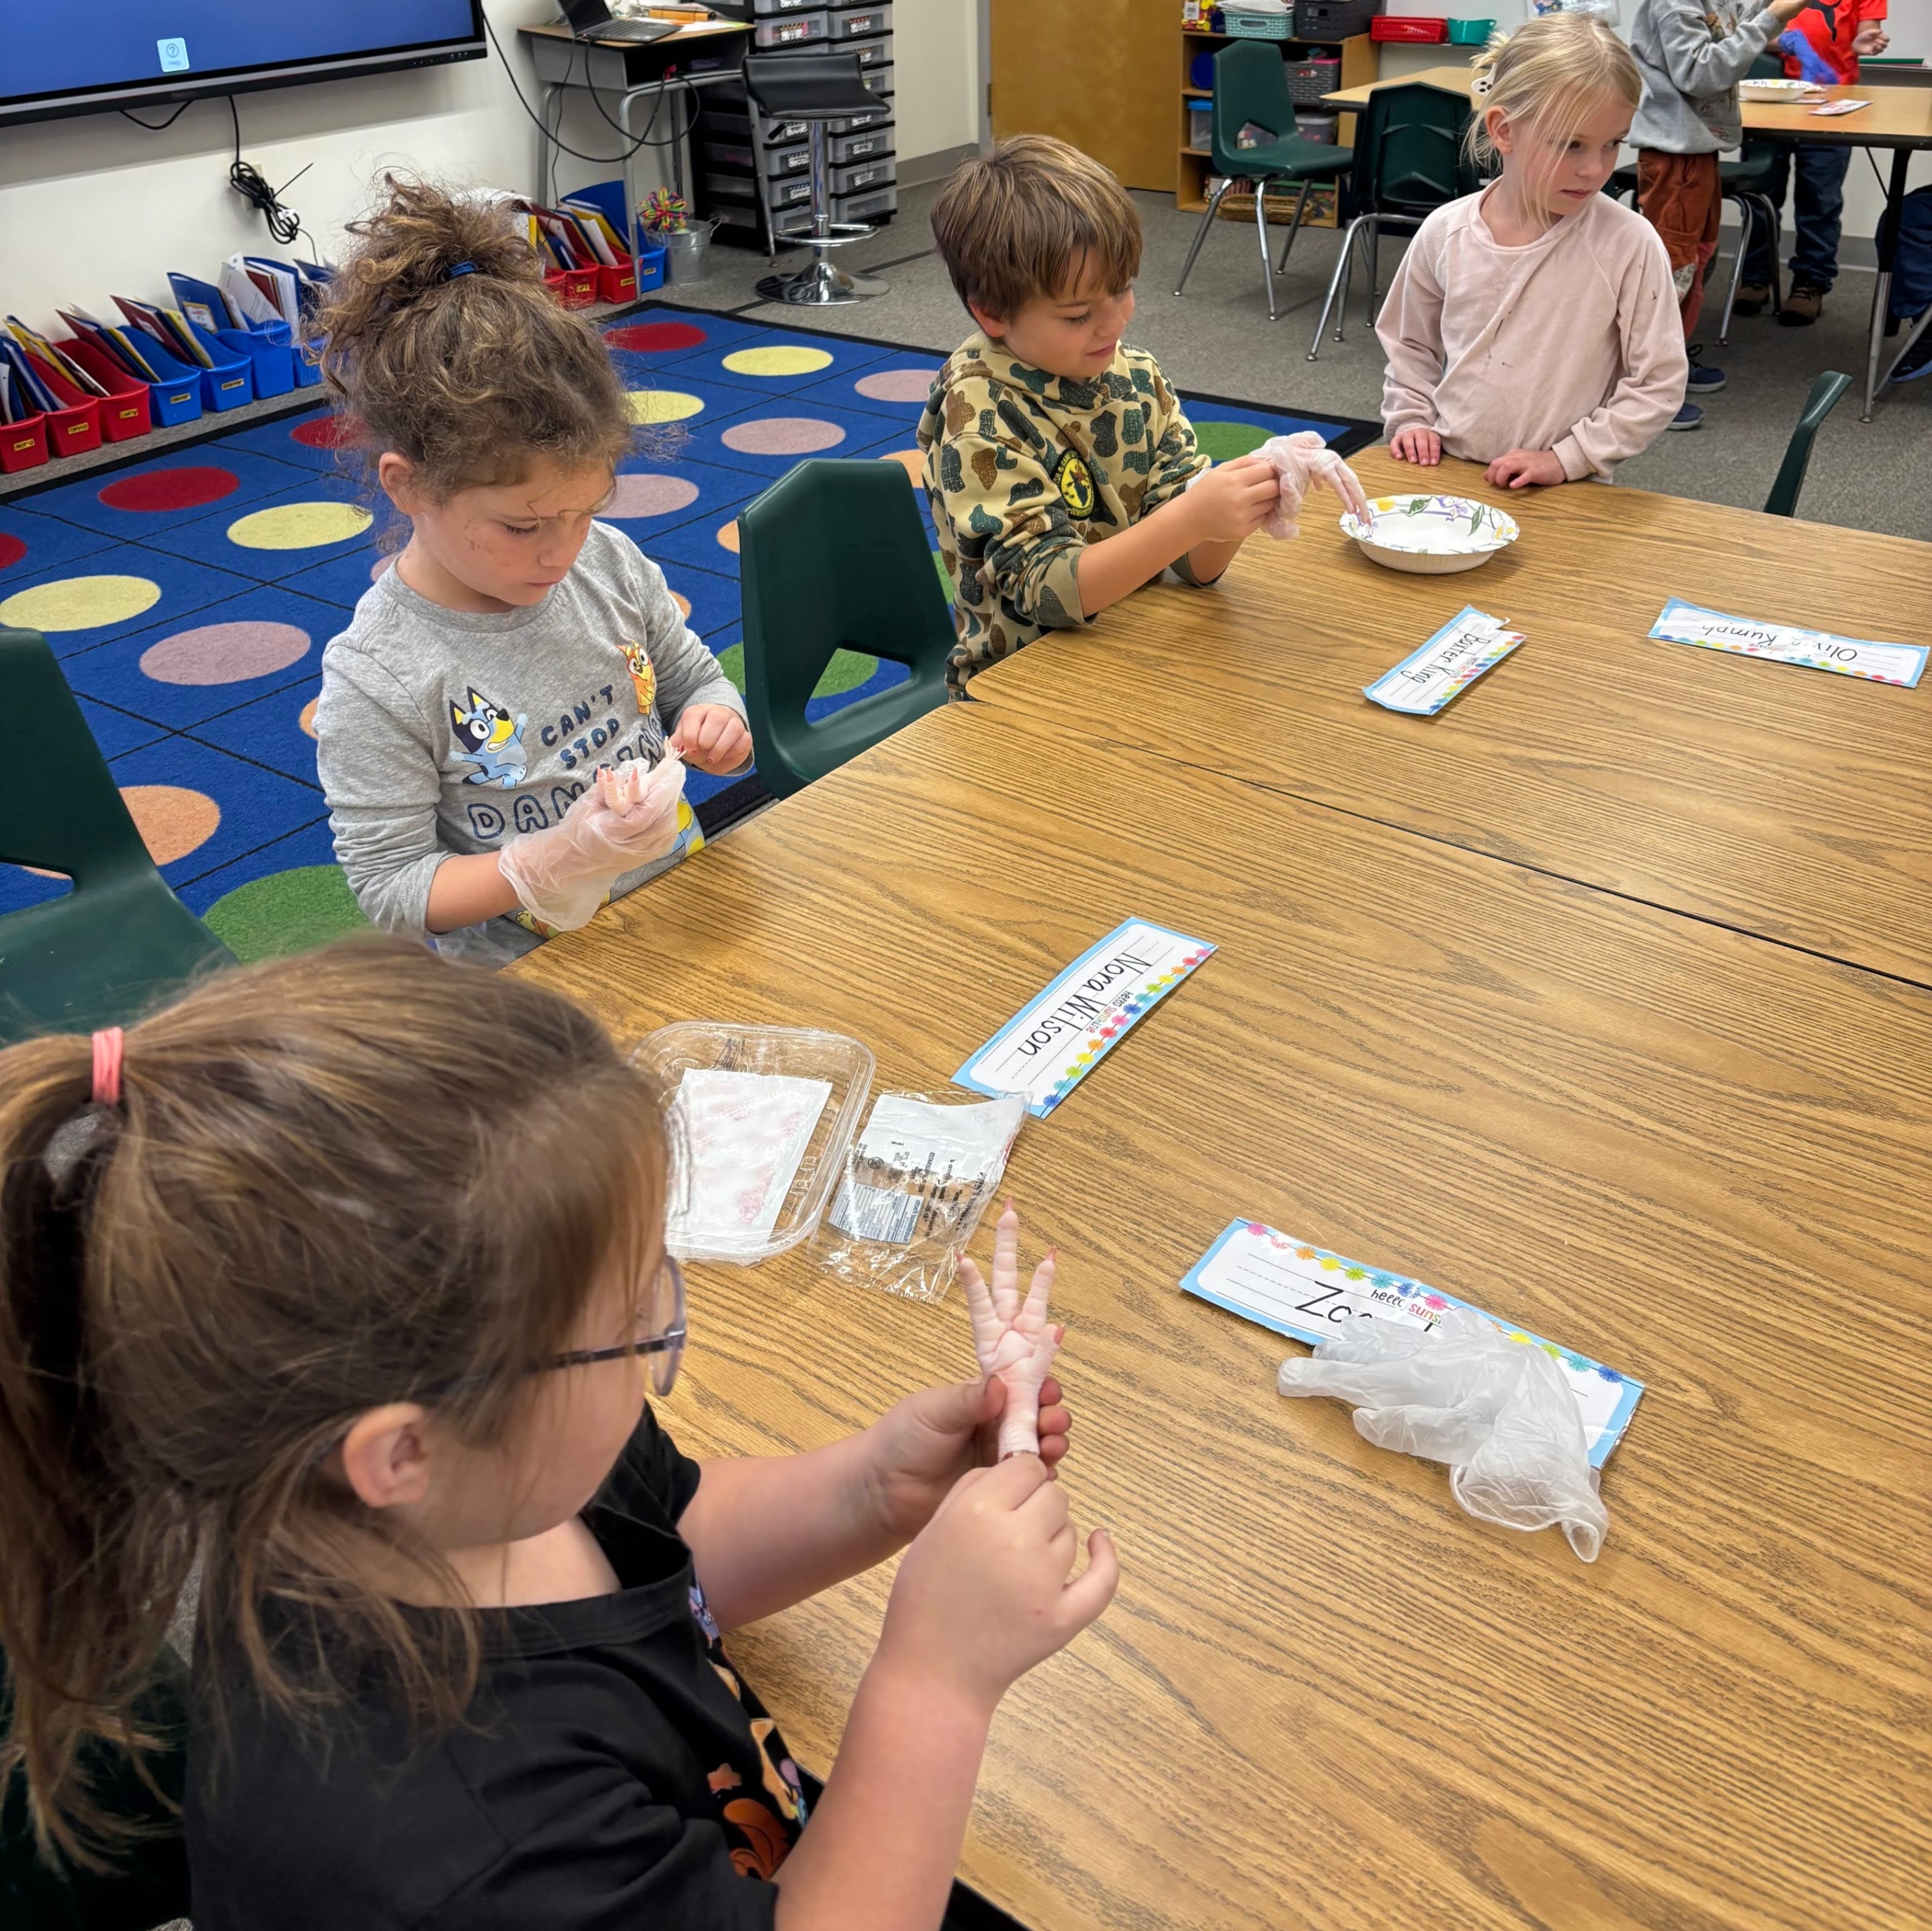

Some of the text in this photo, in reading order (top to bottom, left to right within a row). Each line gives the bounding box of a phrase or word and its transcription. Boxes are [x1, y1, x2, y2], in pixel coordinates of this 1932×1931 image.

[1440, 633, 1491, 663] Baxter
[1791, 640, 1857, 662] Oliv
[1400, 664, 1455, 684] King
[541, 684, 613, 746] CAN'T
[560, 718, 619, 770] STOP
[467, 716, 663, 840] DANNG
[1082, 952, 1153, 992] Nora
[1018, 994, 1108, 1056] Wilson
[1295, 1281, 1372, 1323] Zo
[1408, 1303, 1441, 1324] suns
